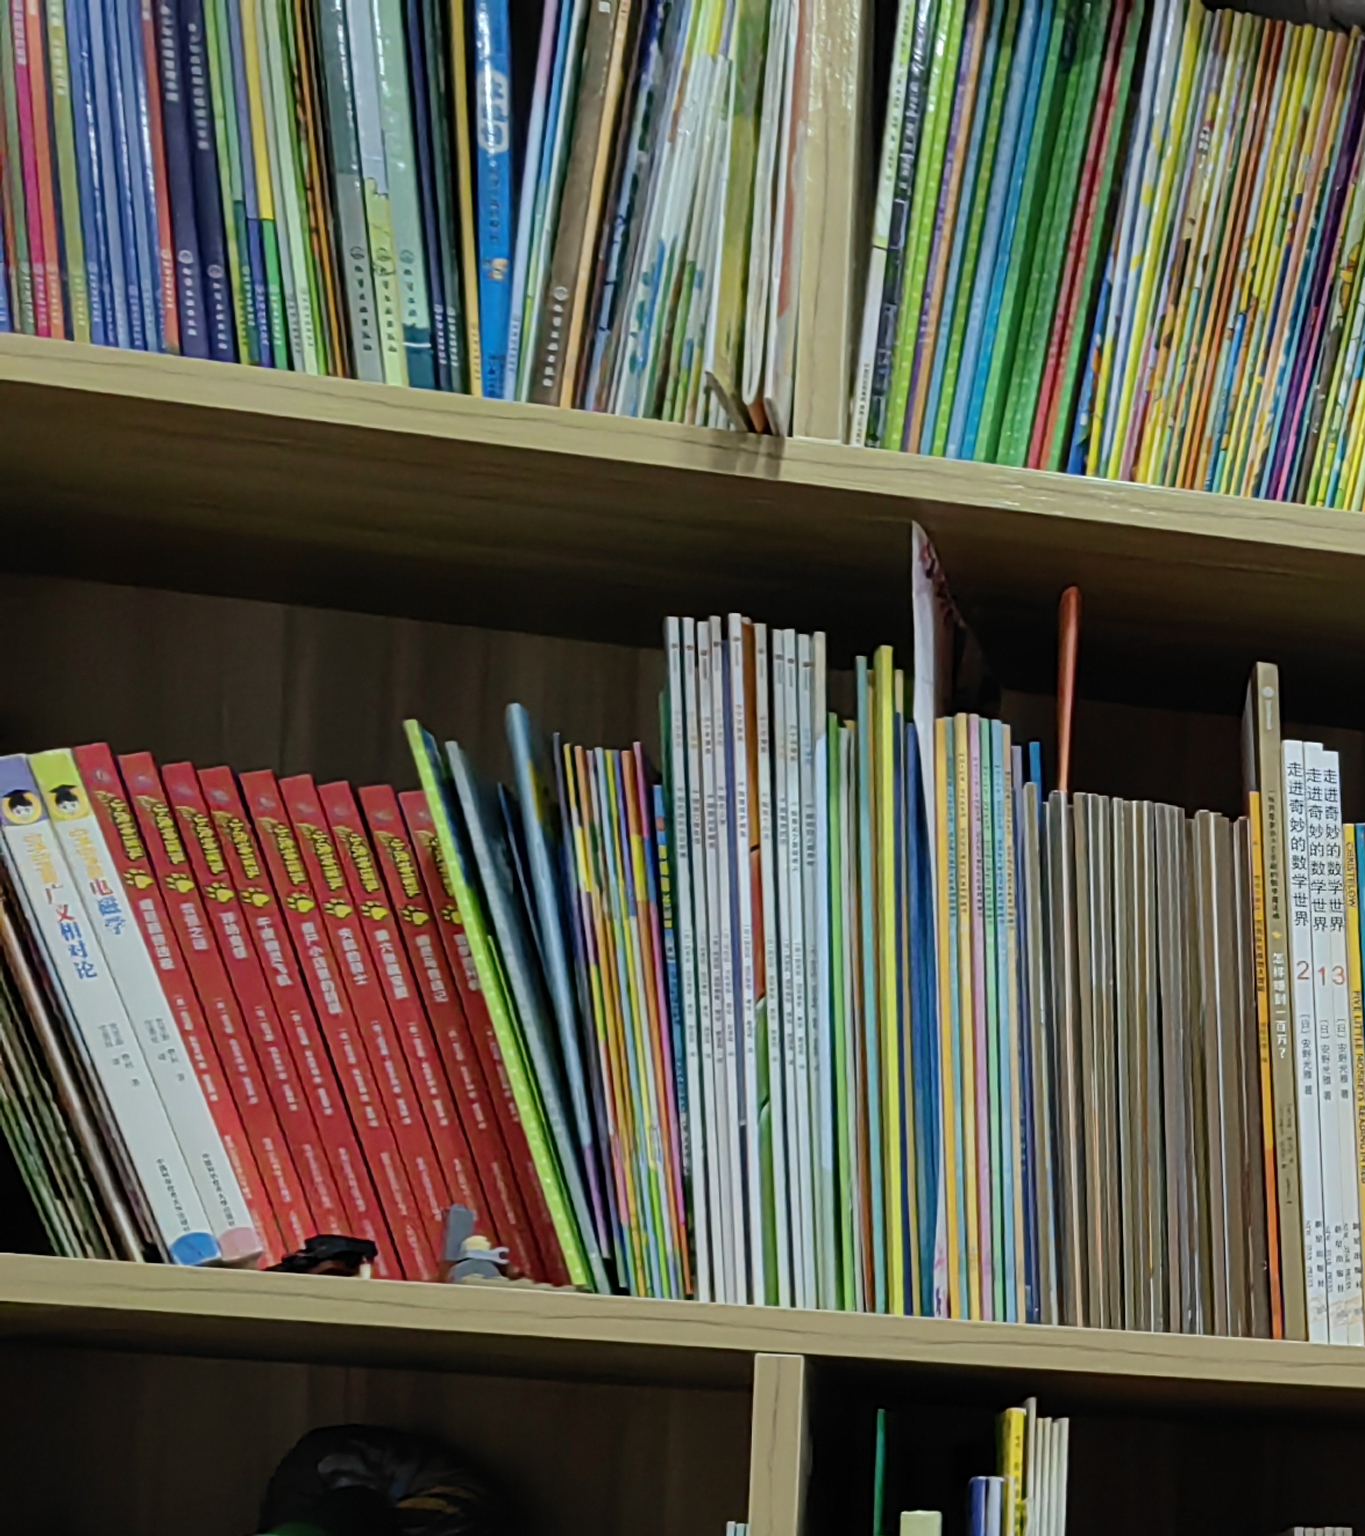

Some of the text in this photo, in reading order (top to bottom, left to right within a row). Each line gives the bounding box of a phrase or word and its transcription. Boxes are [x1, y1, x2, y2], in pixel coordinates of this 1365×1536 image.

[1287, 762, 1310, 980] 走进奇妙的数学世界 2
[1306, 768, 1327, 986] 走进奇妙的数学世界 1
[1323, 769, 1345, 985] 走进奇妙的数学世界 3
[1346, 842, 1357, 908] CHRISTELOW
